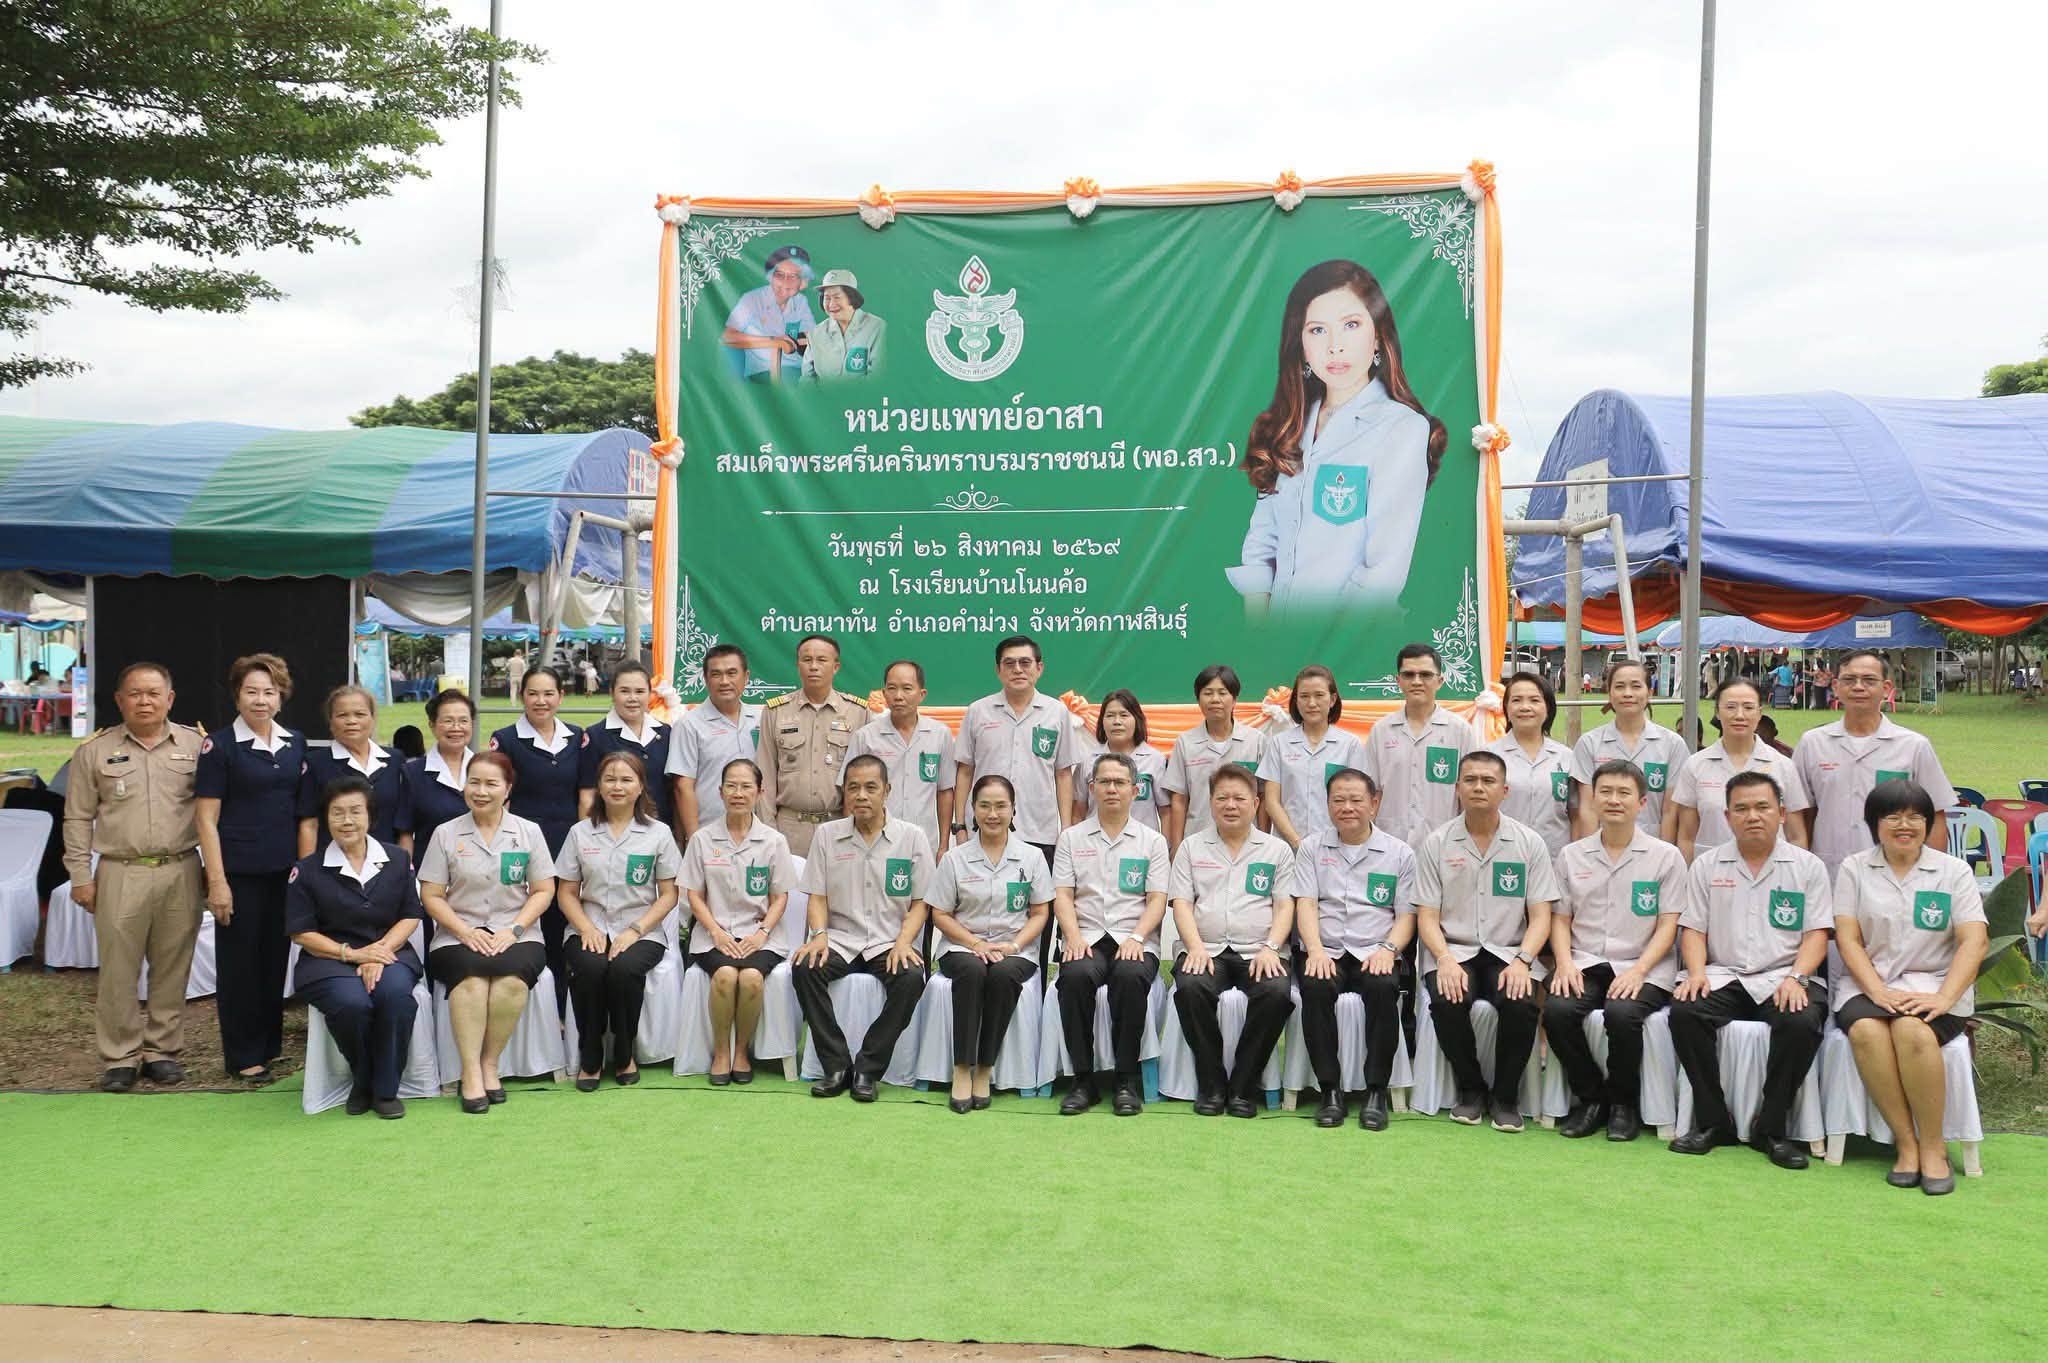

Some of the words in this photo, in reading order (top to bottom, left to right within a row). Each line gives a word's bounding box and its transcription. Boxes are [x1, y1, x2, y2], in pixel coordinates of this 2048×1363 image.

[844, 391, 1103, 433] หน่วยแพทย์อาสา
[716, 440, 1126, 473] สมเด็จพระศรีนครินทราบรมราชชนนี
[1132, 442, 1237, 471] (พอ.สว.)
[827, 525, 903, 566] วันพุธที่
[913, 539, 947, 557] ๒๖
[957, 532, 1041, 557] สิงหาคม
[1052, 537, 1121, 556] ๒๕๖๙
[859, 578, 880, 595] ณ
[888, 567, 1088, 595] โรงเรียนบ้านโนนค้อ
[760, 607, 877, 633] ตำบลนาทัน
[887, 607, 1018, 633] อำเภอคำม่วง
[1029, 602, 1189, 639] จังหวัดกาฬสินธุ์
